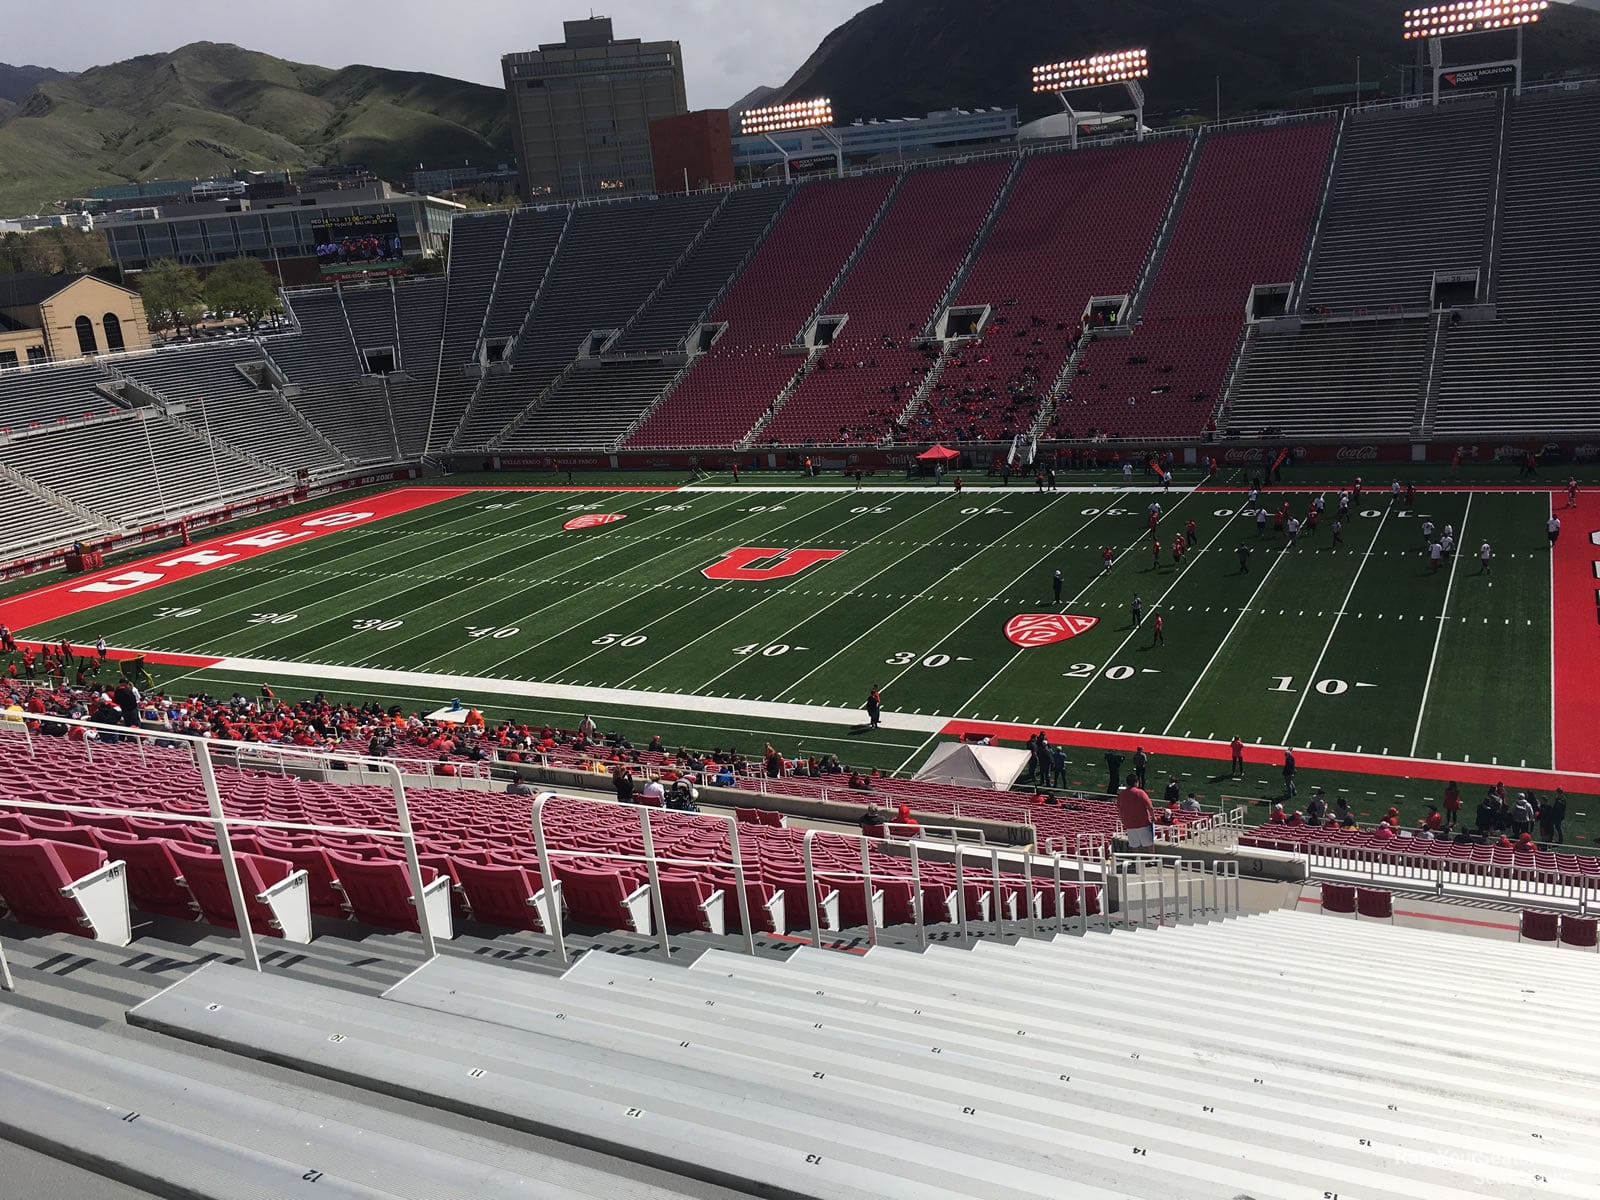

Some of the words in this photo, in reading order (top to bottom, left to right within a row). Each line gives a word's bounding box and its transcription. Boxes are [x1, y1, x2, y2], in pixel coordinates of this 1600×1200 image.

[1479, 67, 1513, 76] MOUNTAIN
[1456, 75, 1478, 83] POWER
[700, 546, 849, 581] U
[246, 613, 298, 624] 20
[352, 619, 404, 631] 30
[467, 626, 520, 639] 40
[591, 633, 648, 648] 50
[731, 642, 790, 657] 40
[885, 651, 951, 668] 30
[1061, 662, 1135, 681] 20
[1267, 676, 1348, 695] 10
[108, 866, 121, 878] 46
[555, 1013, 568, 1021] 10
[330, 1033, 345, 1044] 10
[469, 1068, 484, 1078] 11
[812, 1071, 825, 1080] 12
[626, 1107, 642, 1118] 12
[962, 1106, 976, 1115] 13
[1202, 1105, 1215, 1113] 14
[122, 1111, 141, 1123] 11
[1358, 1138, 1372, 1147] 15
[1132, 1147, 1147, 1156] 14
[805, 1153, 822, 1166] 13
[302, 1169, 324, 1183] 12
